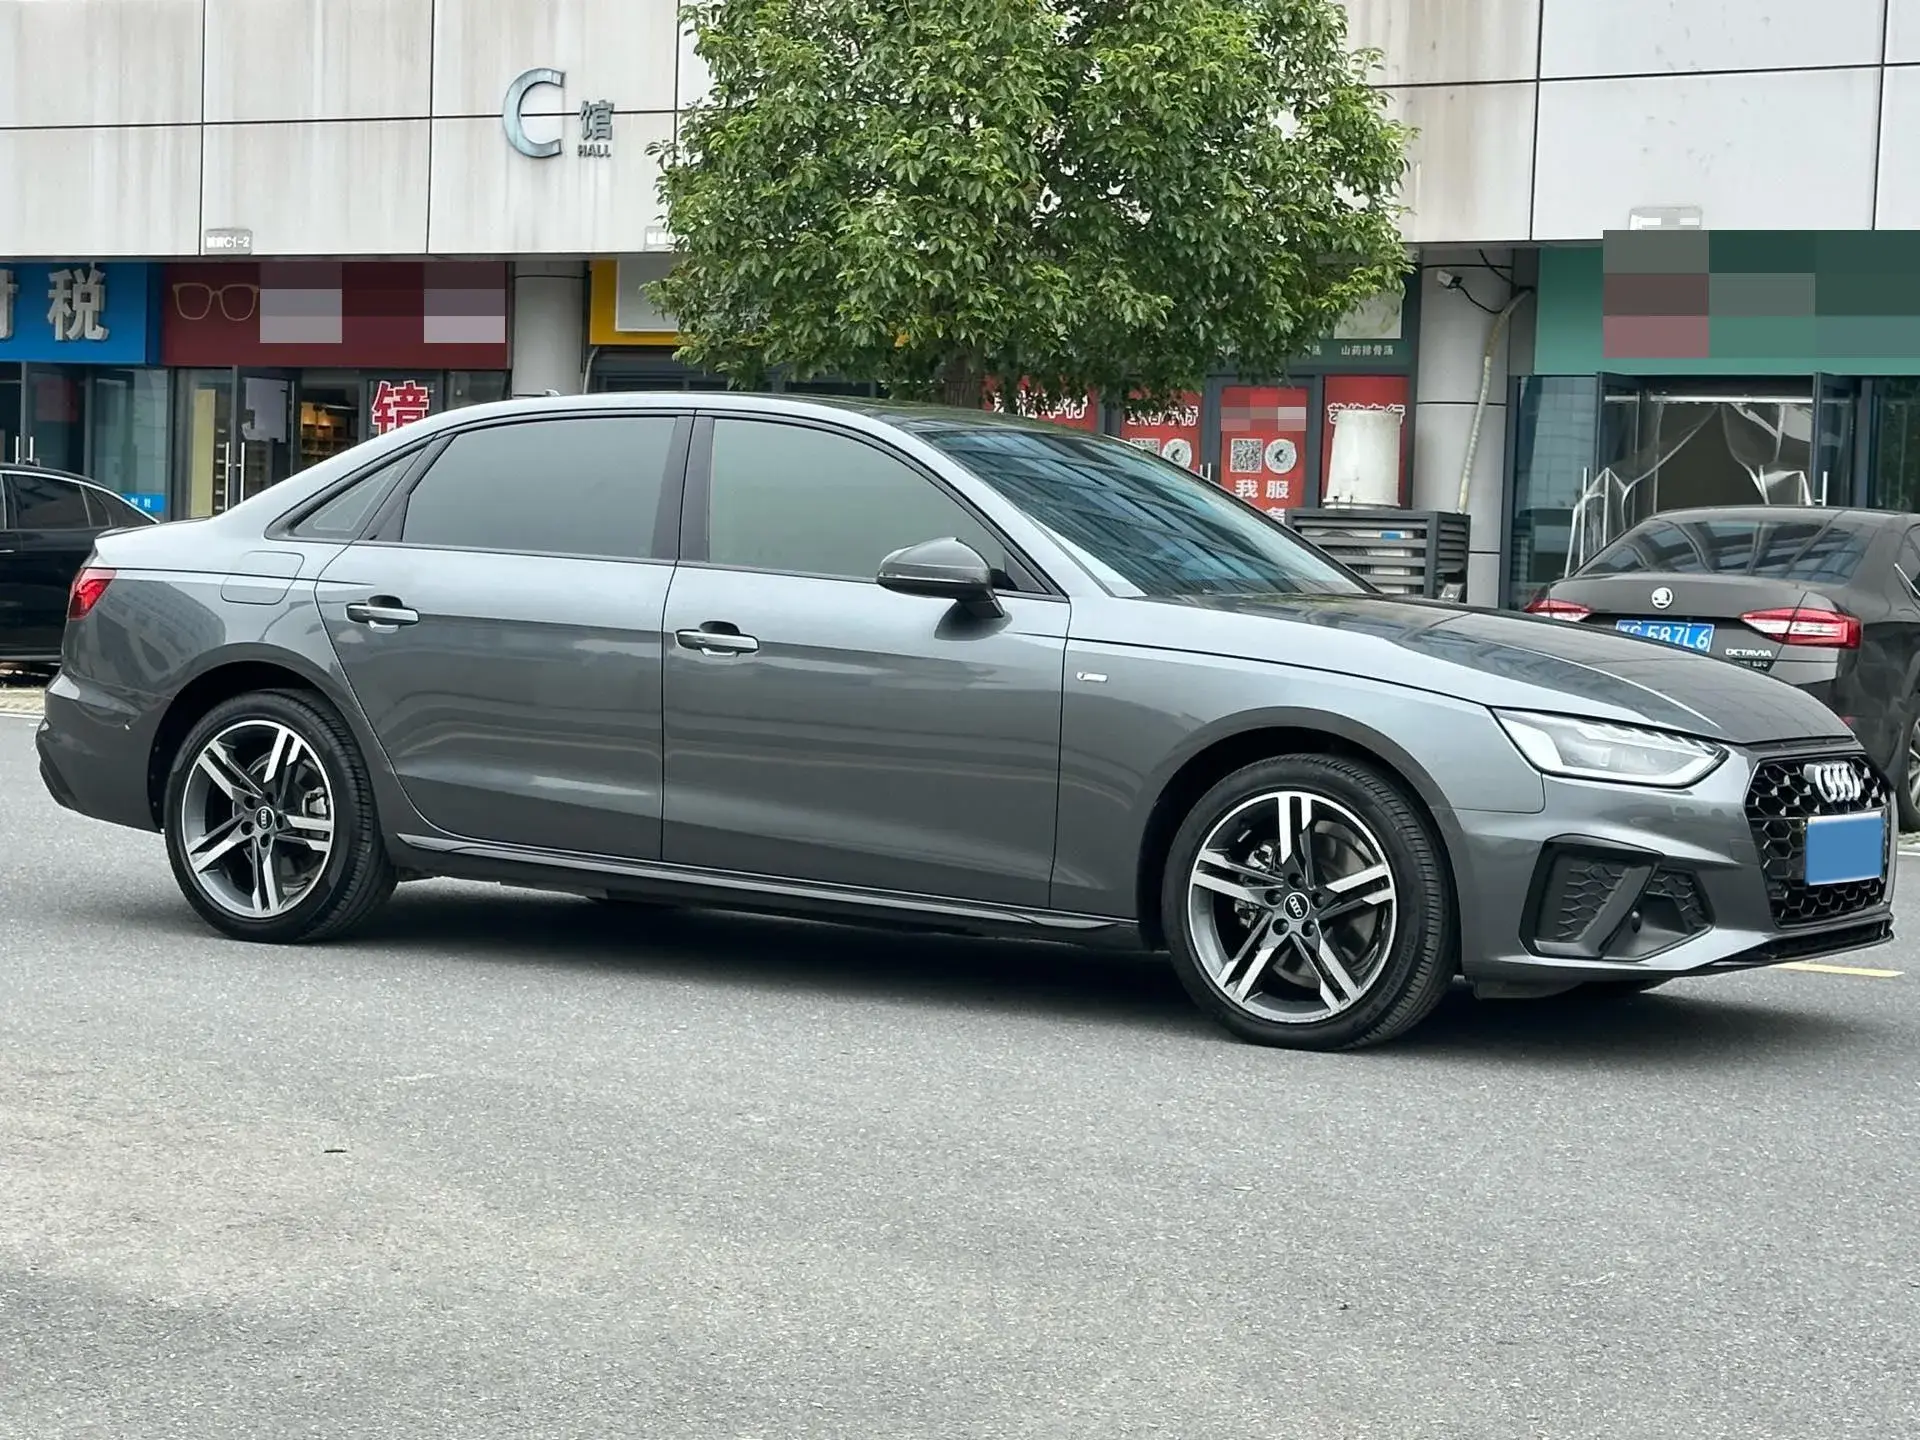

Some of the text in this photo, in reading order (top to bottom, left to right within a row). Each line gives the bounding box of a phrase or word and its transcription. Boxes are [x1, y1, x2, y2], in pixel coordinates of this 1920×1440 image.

[503, 67, 566, 159] C
[580, 99, 614, 141] 馆
[577, 144, 612, 158] HALL
[371, 380, 429, 435] 镜
[1725, 648, 1772, 657] OCTAVIA
